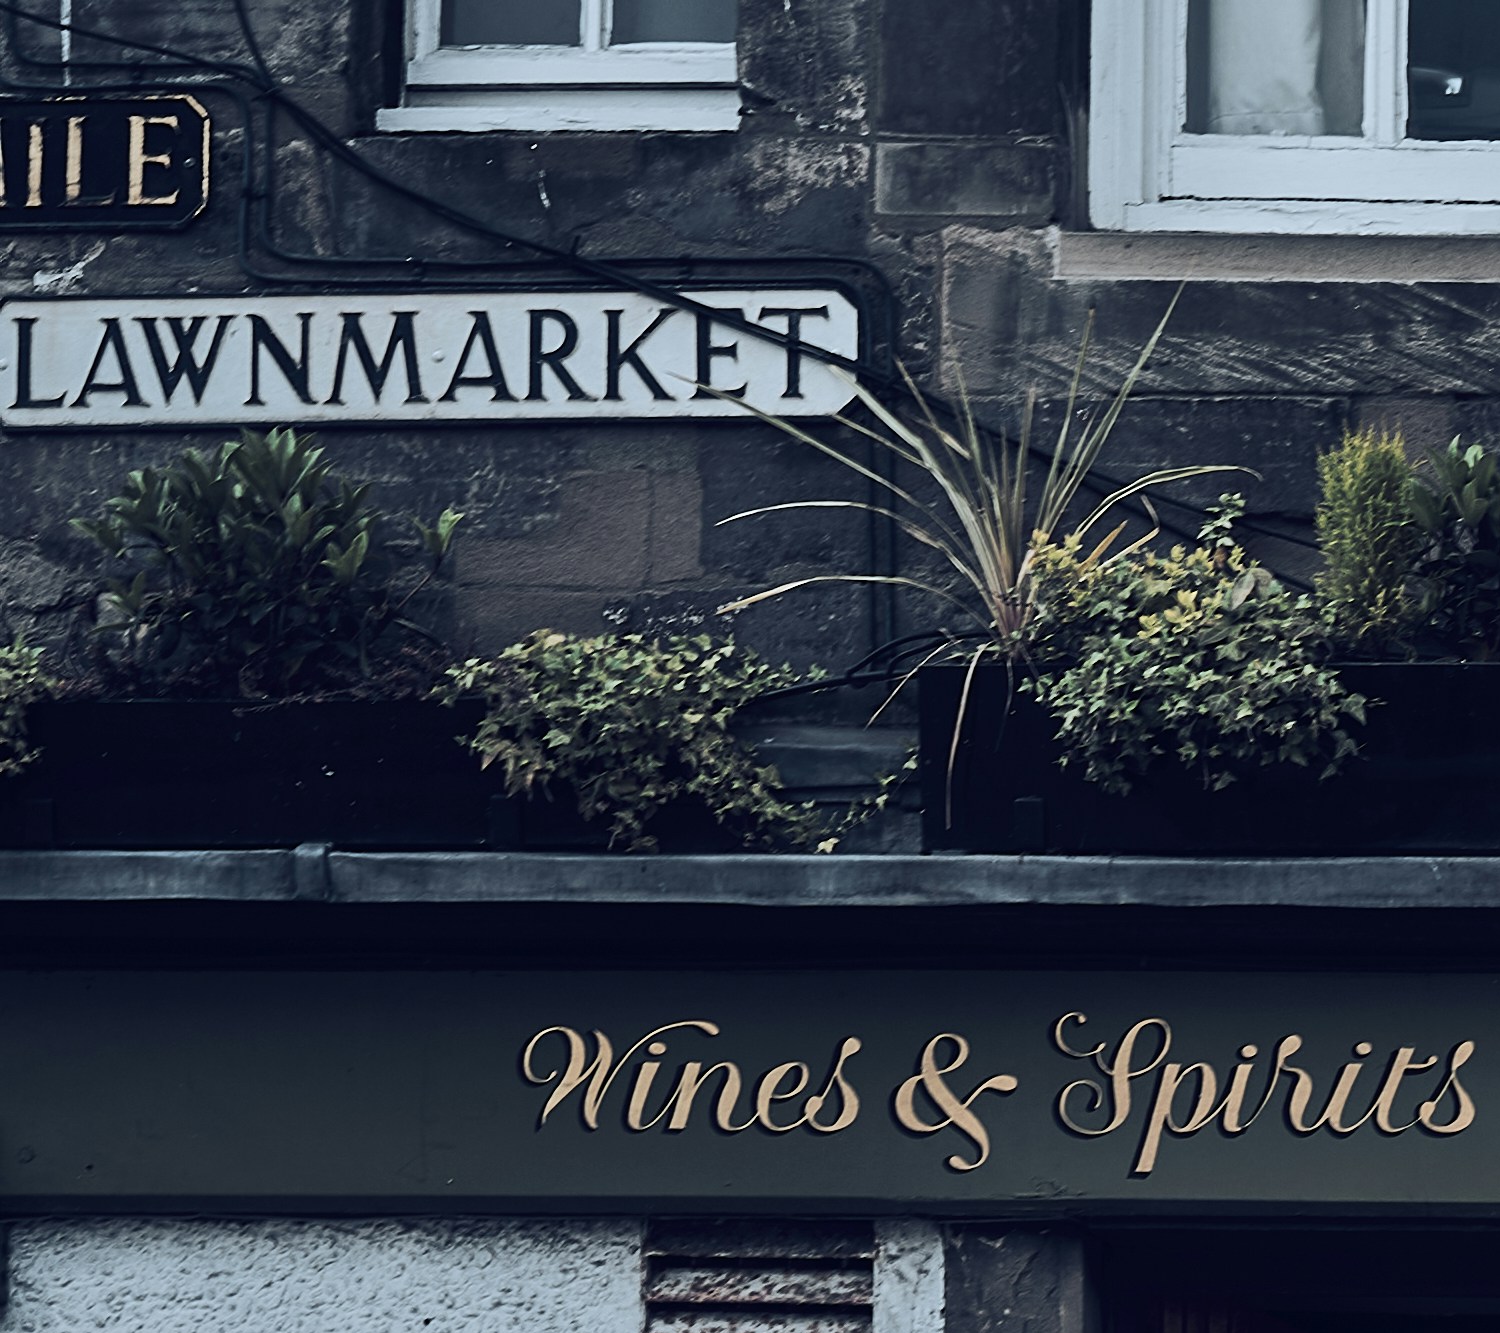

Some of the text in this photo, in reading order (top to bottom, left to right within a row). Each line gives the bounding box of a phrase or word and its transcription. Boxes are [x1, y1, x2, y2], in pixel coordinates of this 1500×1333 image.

[0, 115, 179, 207] ILE
[10, 305, 831, 409] LAWNMARKET
[521, 1011, 1478, 1174] Wines & Spirits
